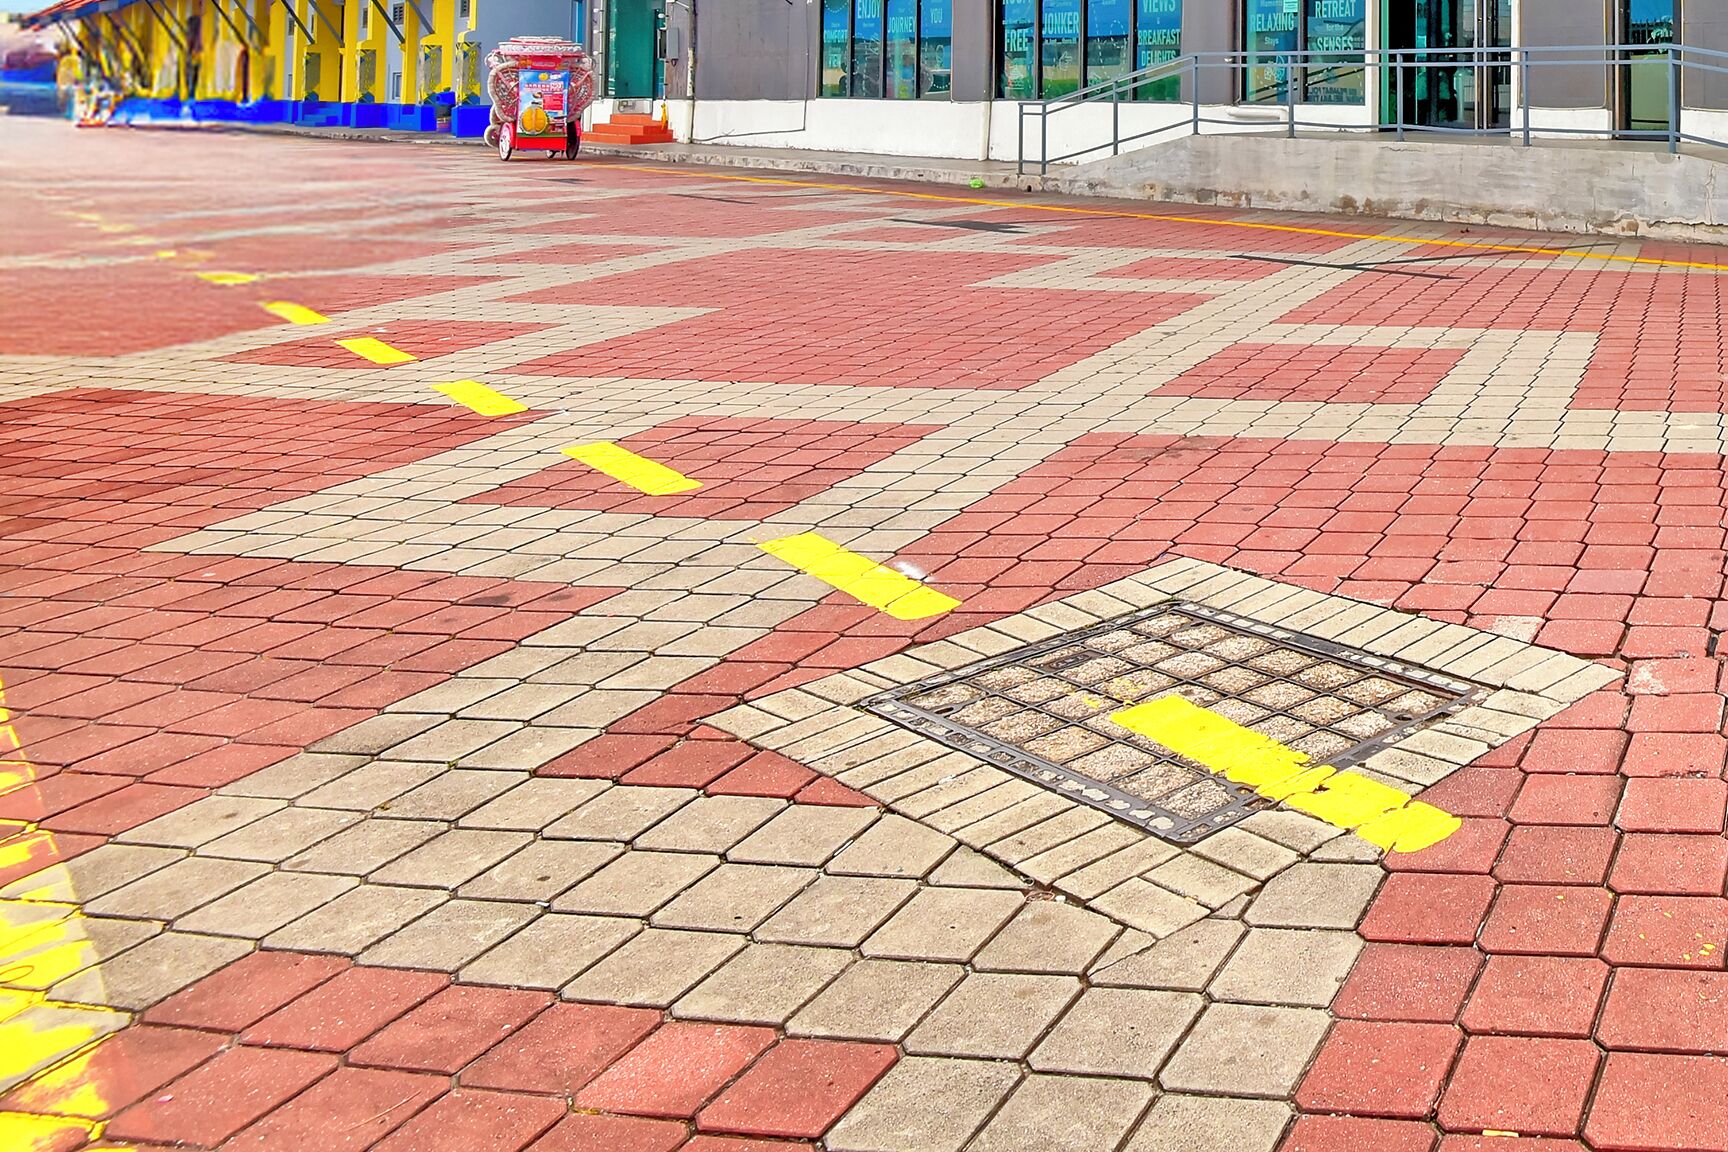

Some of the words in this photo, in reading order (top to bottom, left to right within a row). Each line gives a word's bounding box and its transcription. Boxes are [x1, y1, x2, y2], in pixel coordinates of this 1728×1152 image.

[930, 8, 943, 24] YOU
[1315, 0, 1356, 18] RETREAT
[887, 16, 916, 33] JOURNEY
[1042, 12, 1079, 34] JONKER
[1250, 13, 1295, 32] RELAXING
[1005, 29, 1028, 51] FREE
[1138, 29, 1180, 45] BREAKFAST
[1317, 36, 1354, 51] SENSES
[1141, 50, 1176, 66] DELIGHTS
